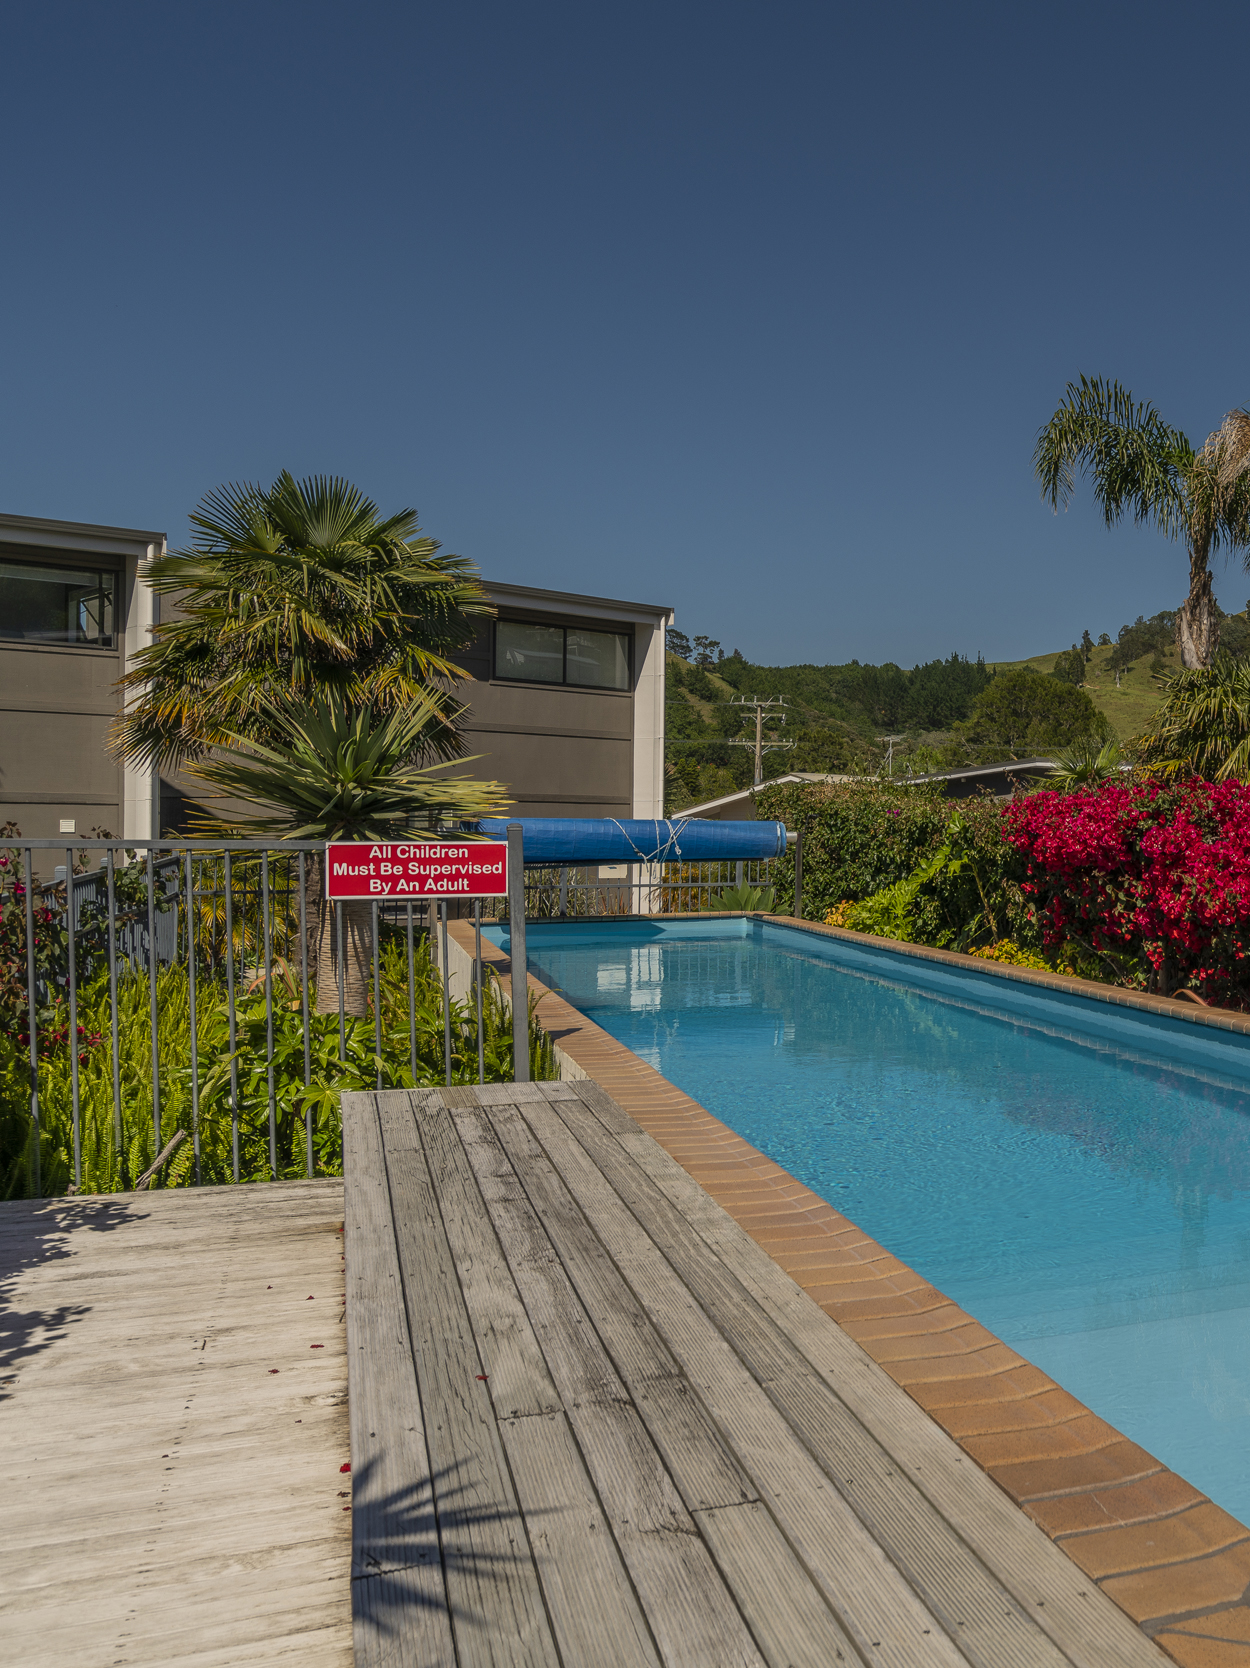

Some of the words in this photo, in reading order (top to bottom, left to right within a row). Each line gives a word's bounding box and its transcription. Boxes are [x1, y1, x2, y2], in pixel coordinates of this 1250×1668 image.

[369, 845, 392, 859] All
[396, 845, 469, 859] Children
[333, 862, 376, 876] Must
[380, 862, 404, 875] Be
[408, 861, 502, 878] Supervised
[369, 879, 392, 895] By
[396, 879, 420, 892] An
[424, 878, 470, 892] Adult
